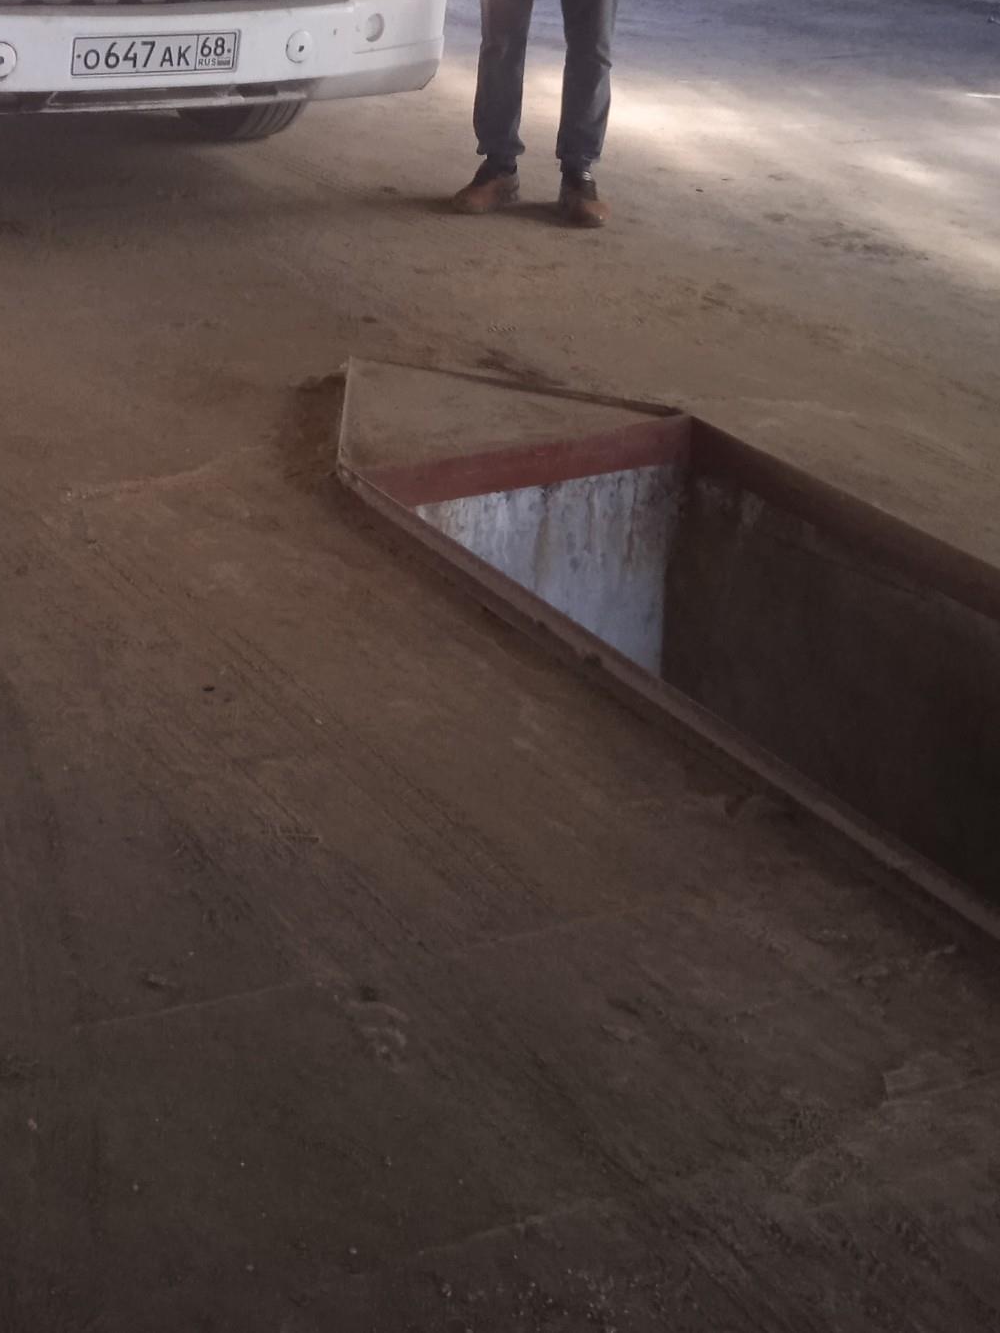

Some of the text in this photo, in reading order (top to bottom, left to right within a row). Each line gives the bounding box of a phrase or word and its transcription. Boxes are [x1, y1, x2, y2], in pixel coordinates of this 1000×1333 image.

[83, 40, 191, 70] О647АК
[200, 36, 226, 58] 68
[198, 58, 216, 67] RUS
